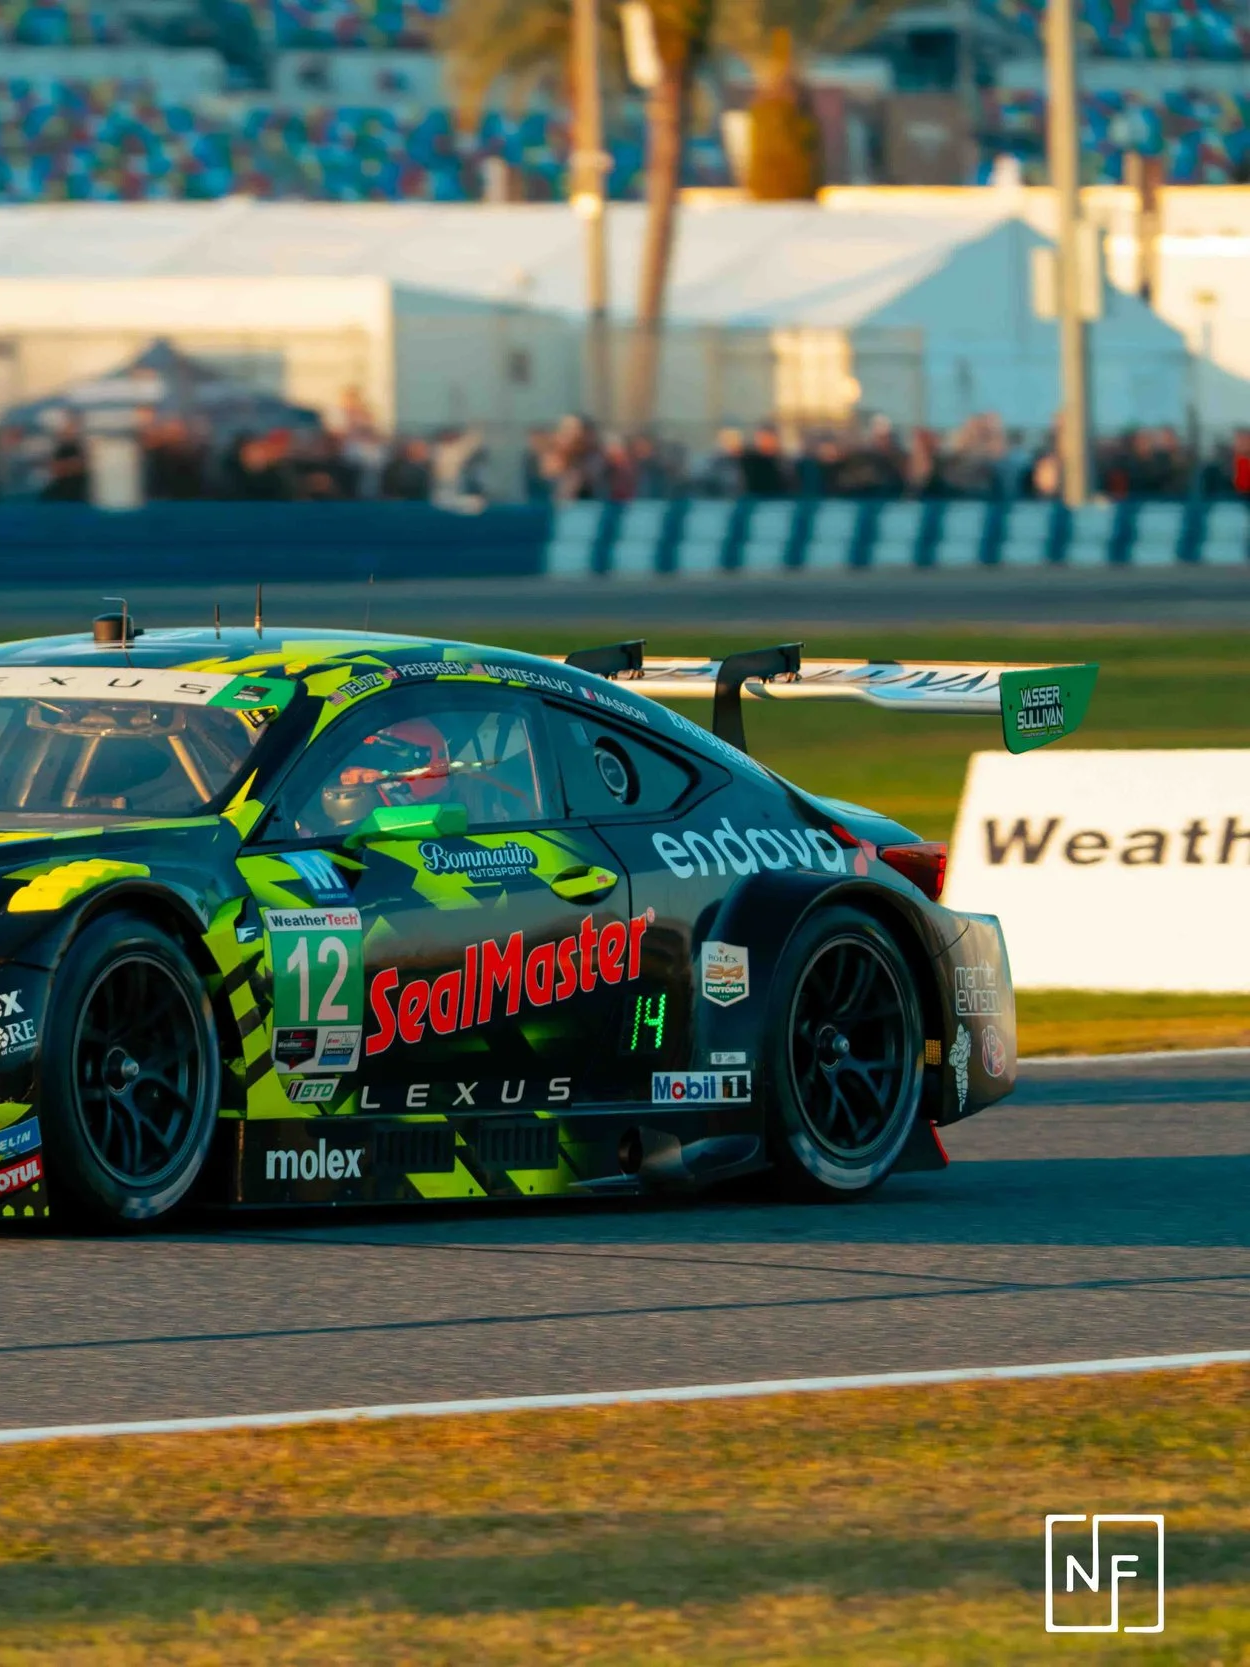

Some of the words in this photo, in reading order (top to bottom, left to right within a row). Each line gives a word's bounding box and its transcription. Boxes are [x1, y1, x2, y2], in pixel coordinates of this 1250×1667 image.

[338, 672, 383, 698] TELITZ
[396, 661, 466, 677] PEDERSEN
[484, 664, 573, 694] MONTECALVO
[593, 691, 649, 724] MASSON
[1020, 685, 1060, 710] VASSER
[1017, 705, 1064, 730] SULLIVAN
[420, 842, 534, 871] Bommarito
[652, 817, 847, 879] endava
[290, 854, 344, 890] M
[468, 866, 527, 878] AUTOSPORT
[270, 912, 358, 928] WeatherTech
[287, 935, 349, 1022] 12
[705, 964, 743, 980] 24
[707, 985, 743, 994] DAYTONA
[631, 994, 666, 1050] 14
[300, 1082, 335, 1098] GTD
[360, 1077, 571, 1109] LEXUS
[654, 1076, 716, 1100] Mobil
[266, 1138, 363, 1180] molex
